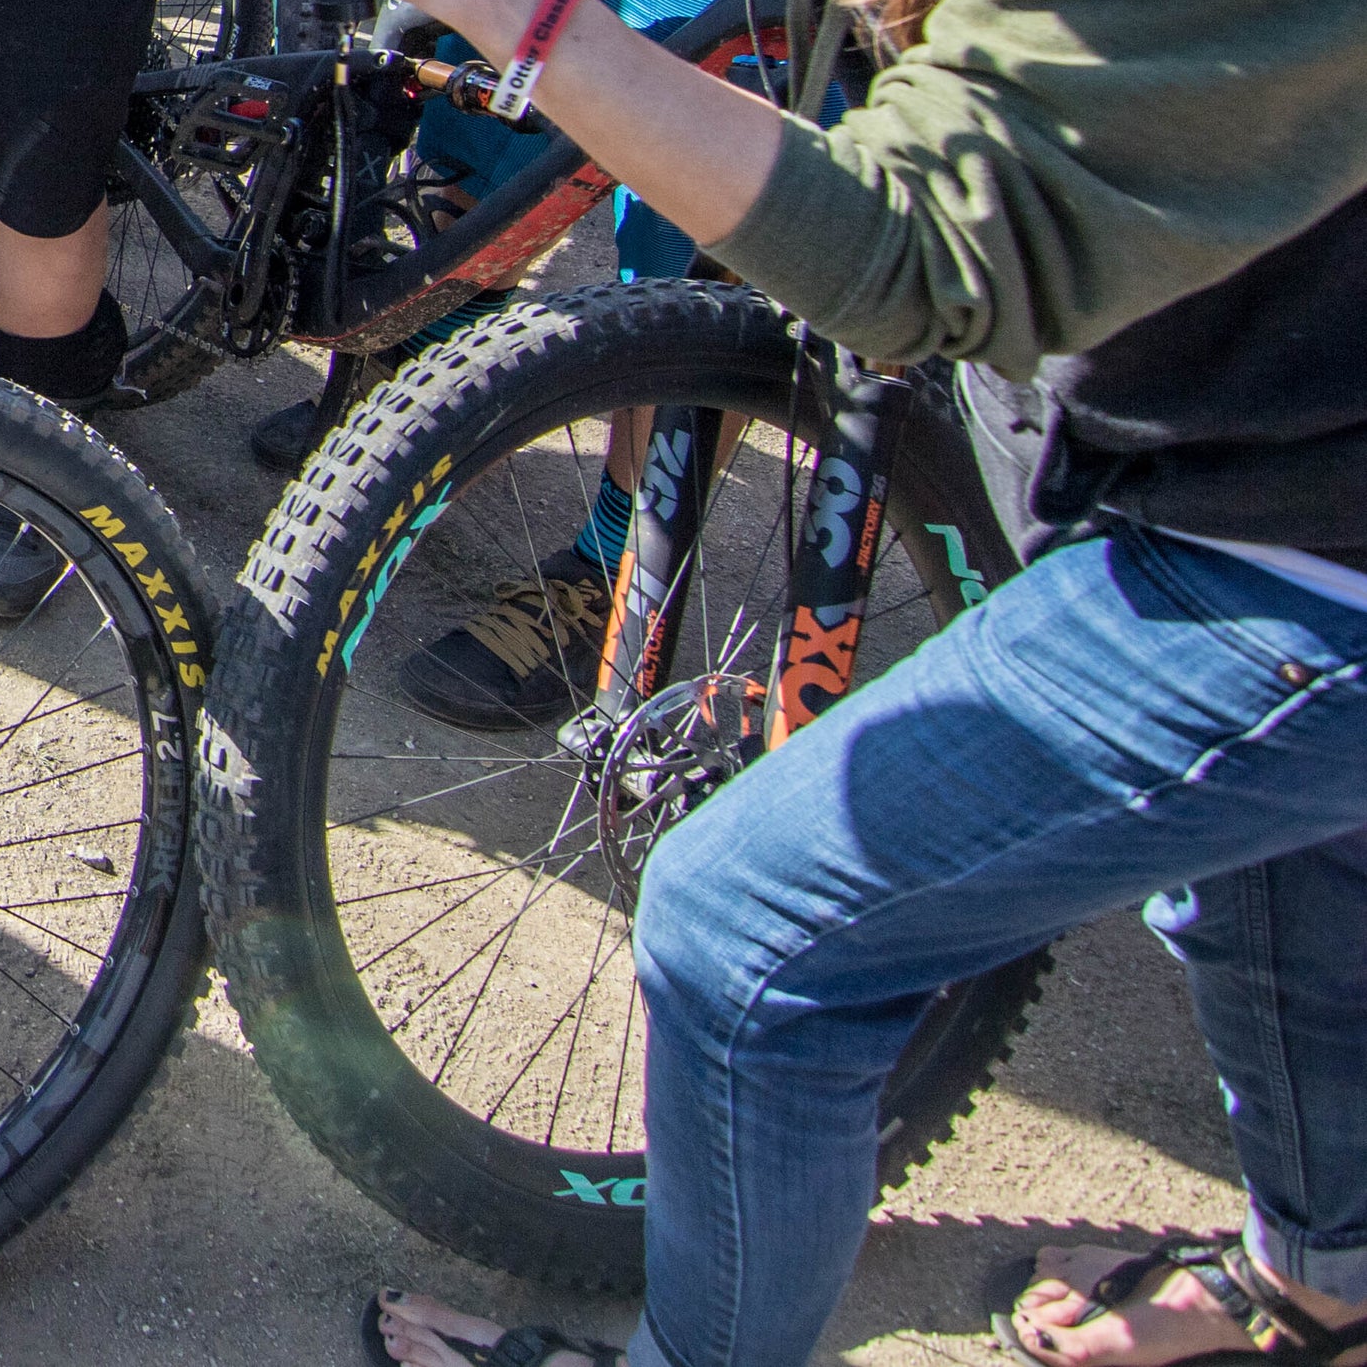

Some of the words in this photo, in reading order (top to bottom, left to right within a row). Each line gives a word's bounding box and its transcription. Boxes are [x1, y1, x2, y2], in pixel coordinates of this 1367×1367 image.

[508, 45, 541, 90] Otter
[78, 503, 207, 689] MAXXIS
[315, 453, 453, 679] MAXXIS
[151, 710, 184, 762] 2.7
